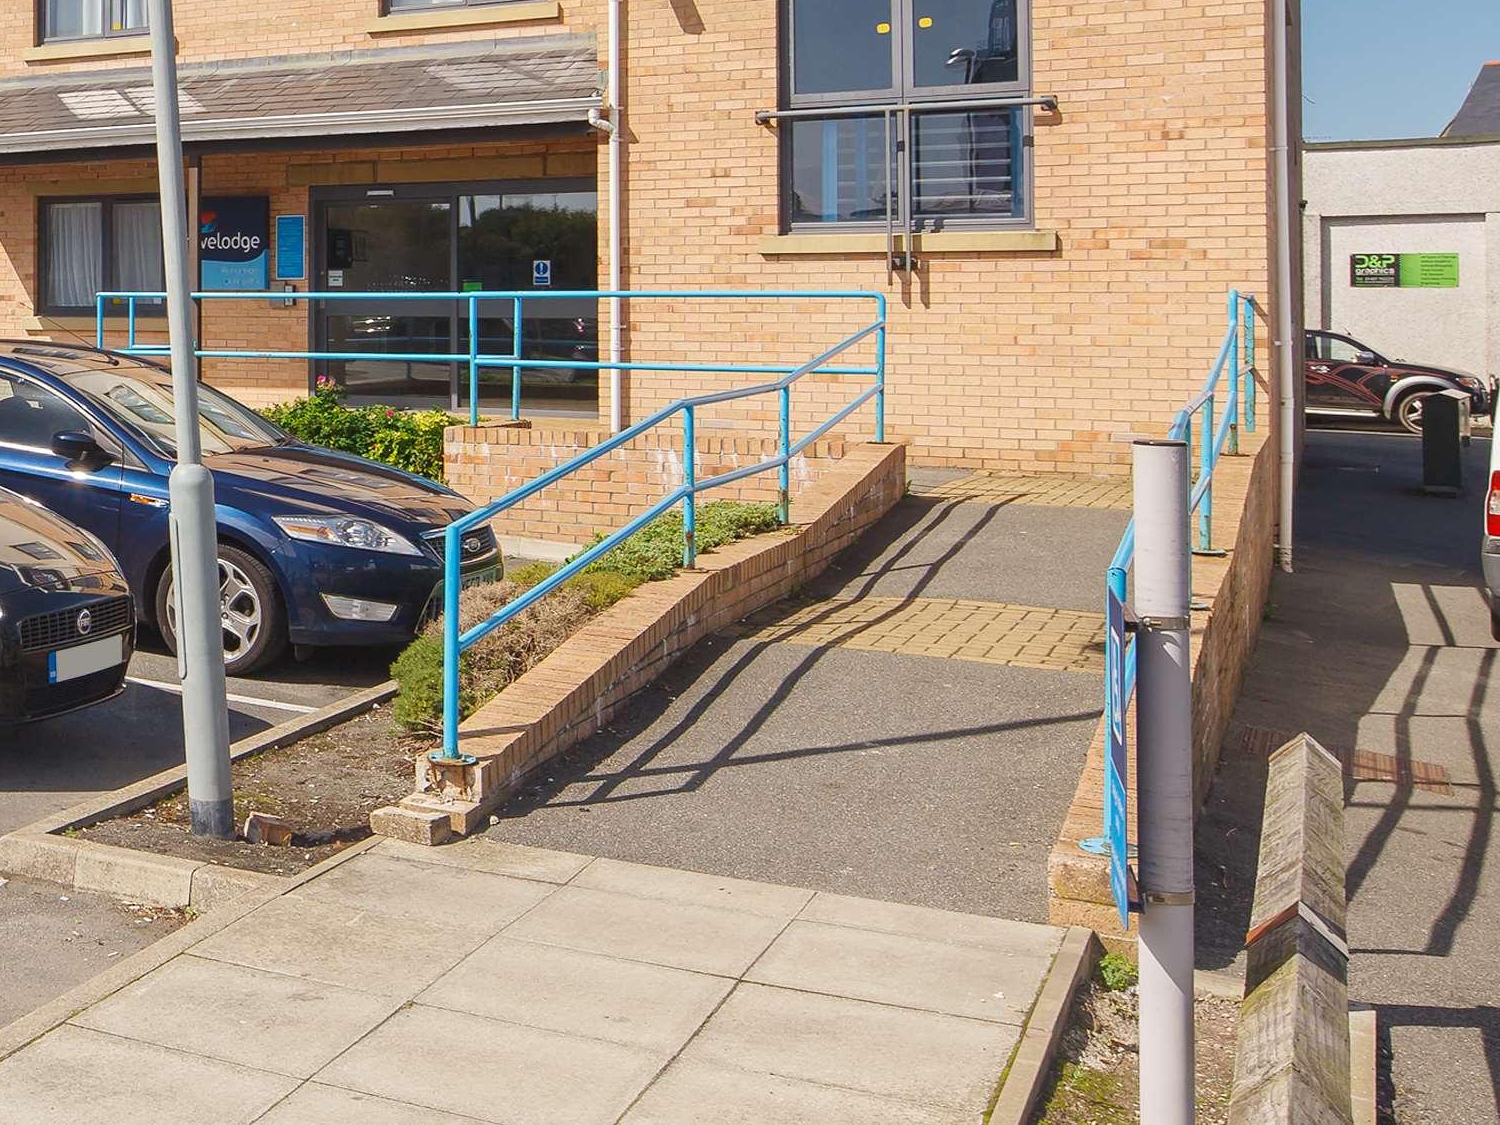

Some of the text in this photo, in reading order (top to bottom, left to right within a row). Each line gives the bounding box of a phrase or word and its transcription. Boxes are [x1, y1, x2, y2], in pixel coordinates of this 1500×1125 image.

[200, 231, 260, 252] velodge
[1355, 255, 1395, 268] D&P
[1355, 267, 1395, 276] graphics
